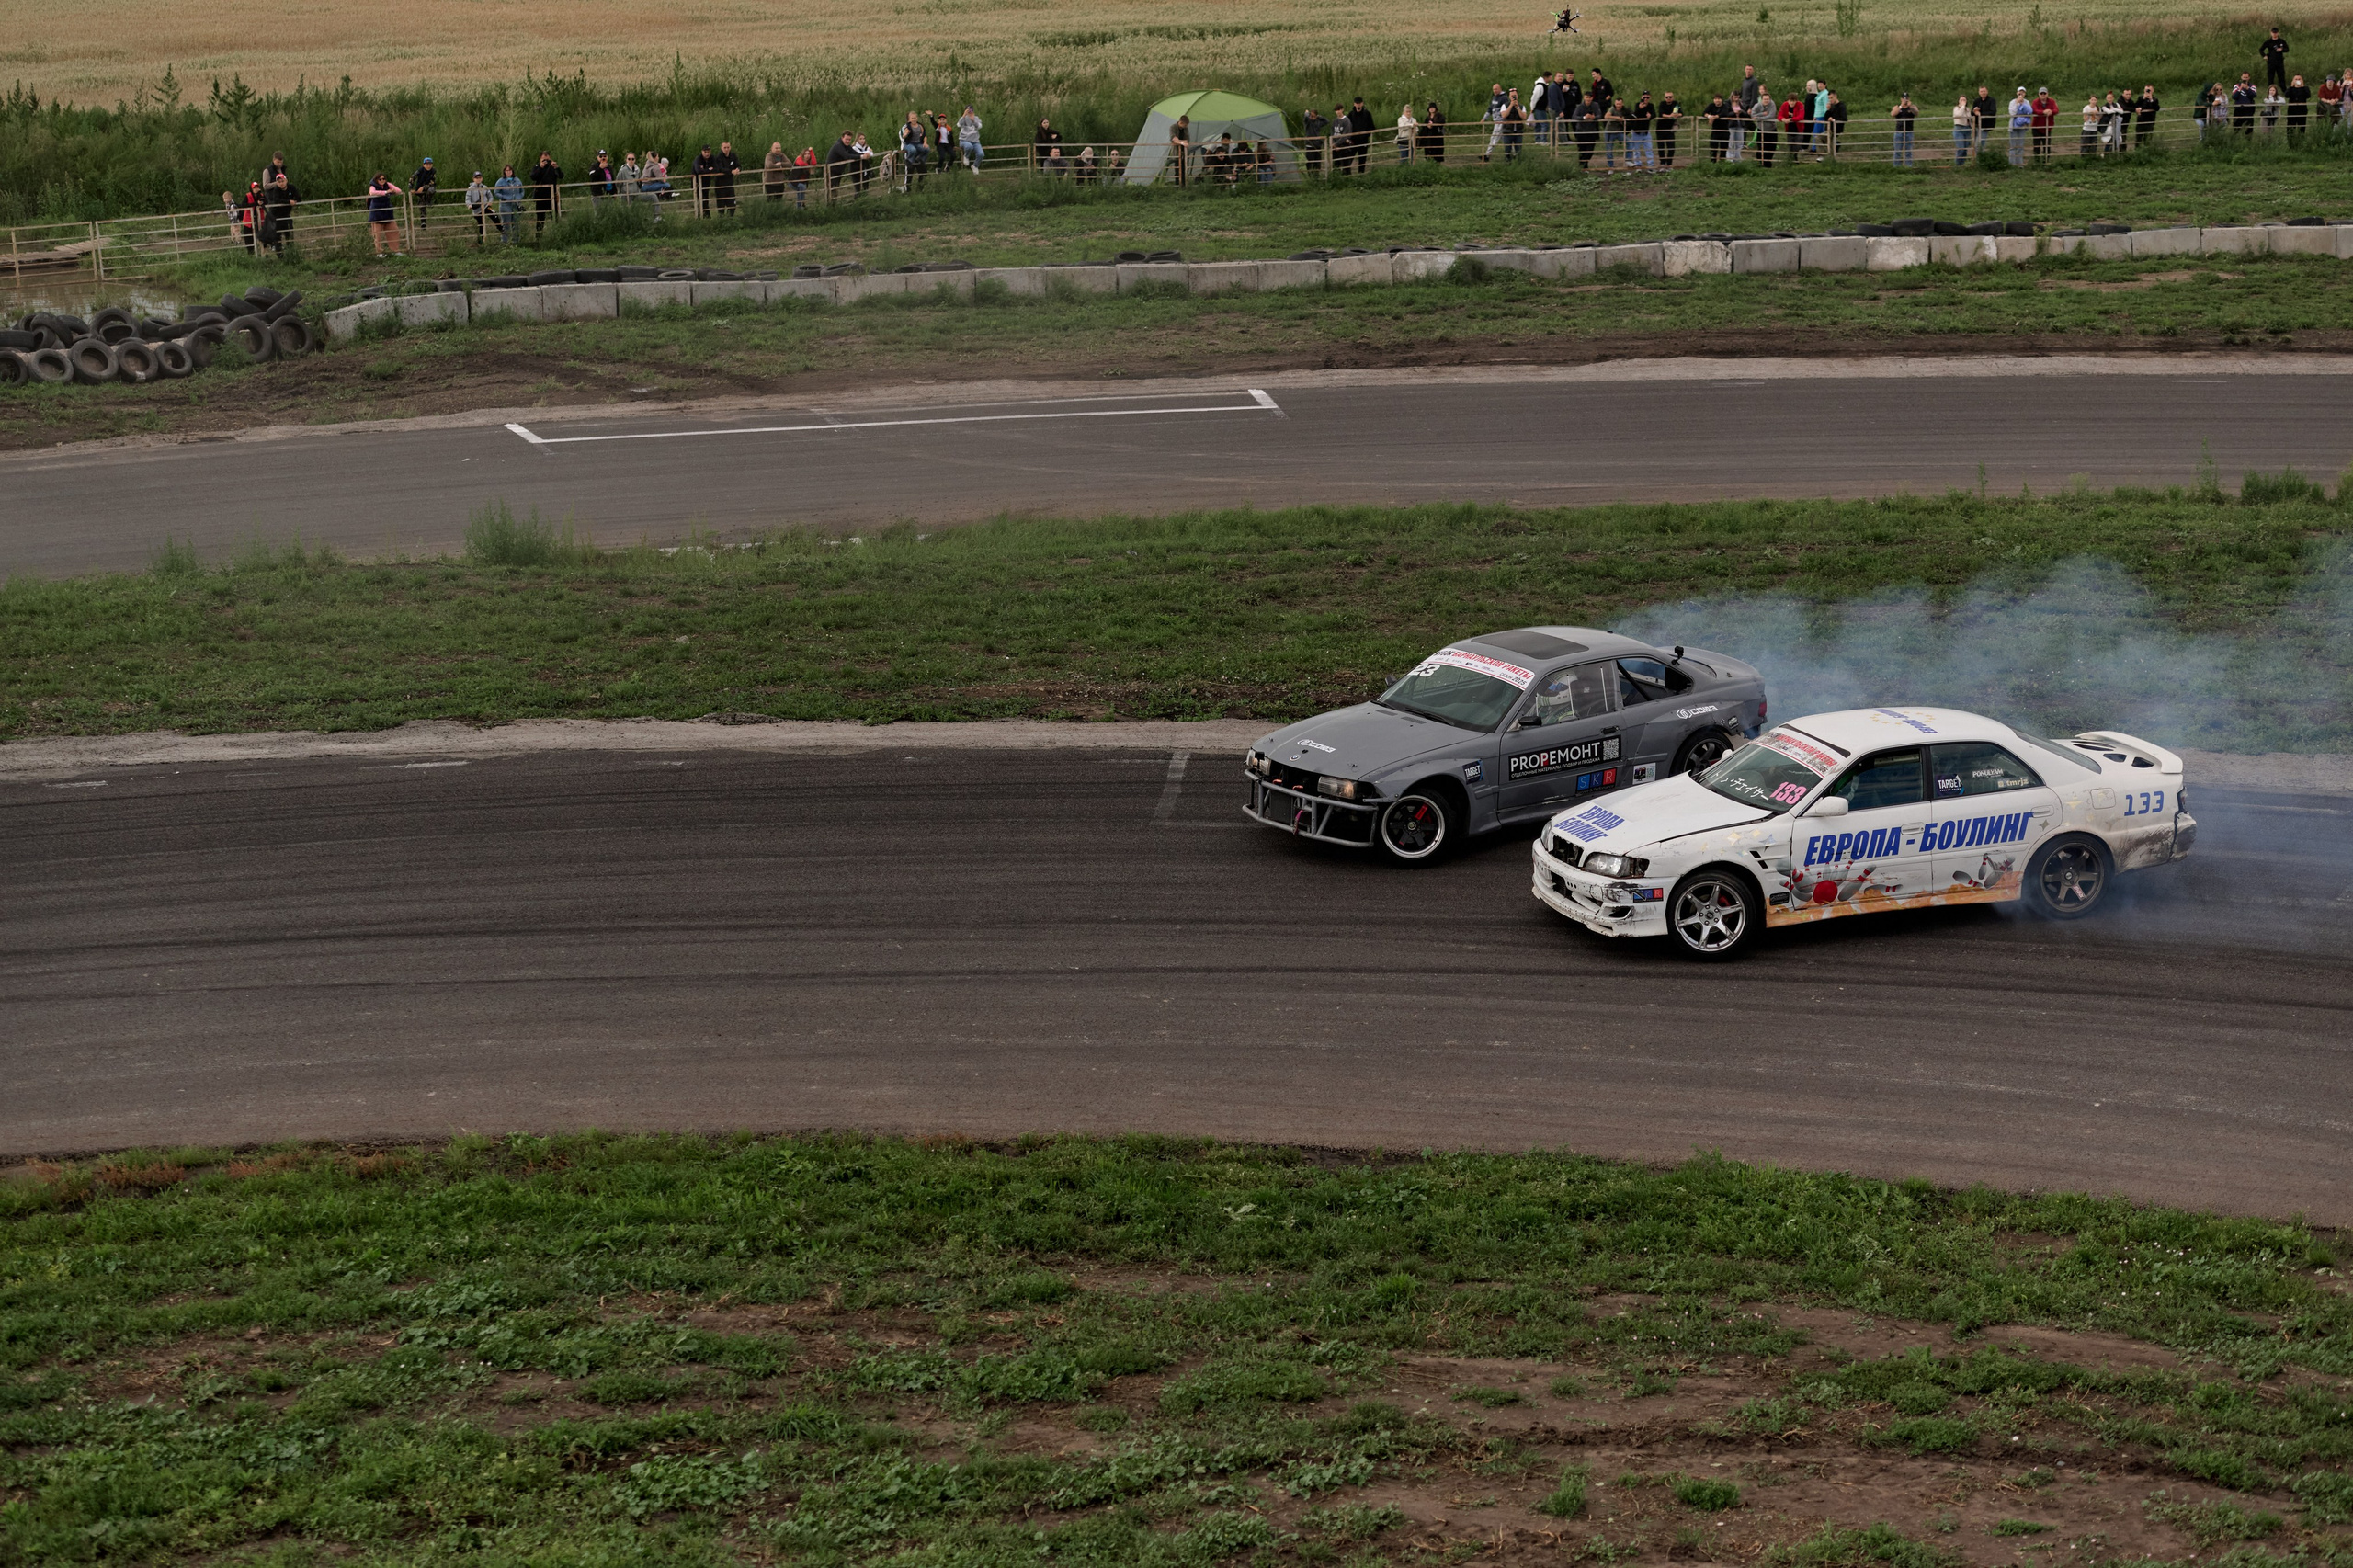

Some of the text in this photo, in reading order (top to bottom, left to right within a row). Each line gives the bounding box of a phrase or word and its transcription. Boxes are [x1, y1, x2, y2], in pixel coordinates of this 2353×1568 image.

[1407, 663, 1441, 676] 23
[1502, 664, 1534, 680] РАКЕТЫ
[1465, 765, 1481, 777] TARGET
[1579, 770, 1614, 789] SKR
[1938, 775, 1962, 789] TARGET
[1769, 781, 1807, 805] 133
[2124, 790, 2165, 816] 133
[1577, 805, 1625, 831] ЕВРОПА
[1554, 817, 1608, 843] БОУЛИНГ
[1803, 827, 1902, 866] ЕВРОПА
[1919, 812, 2034, 852] БОУЛИНГ
